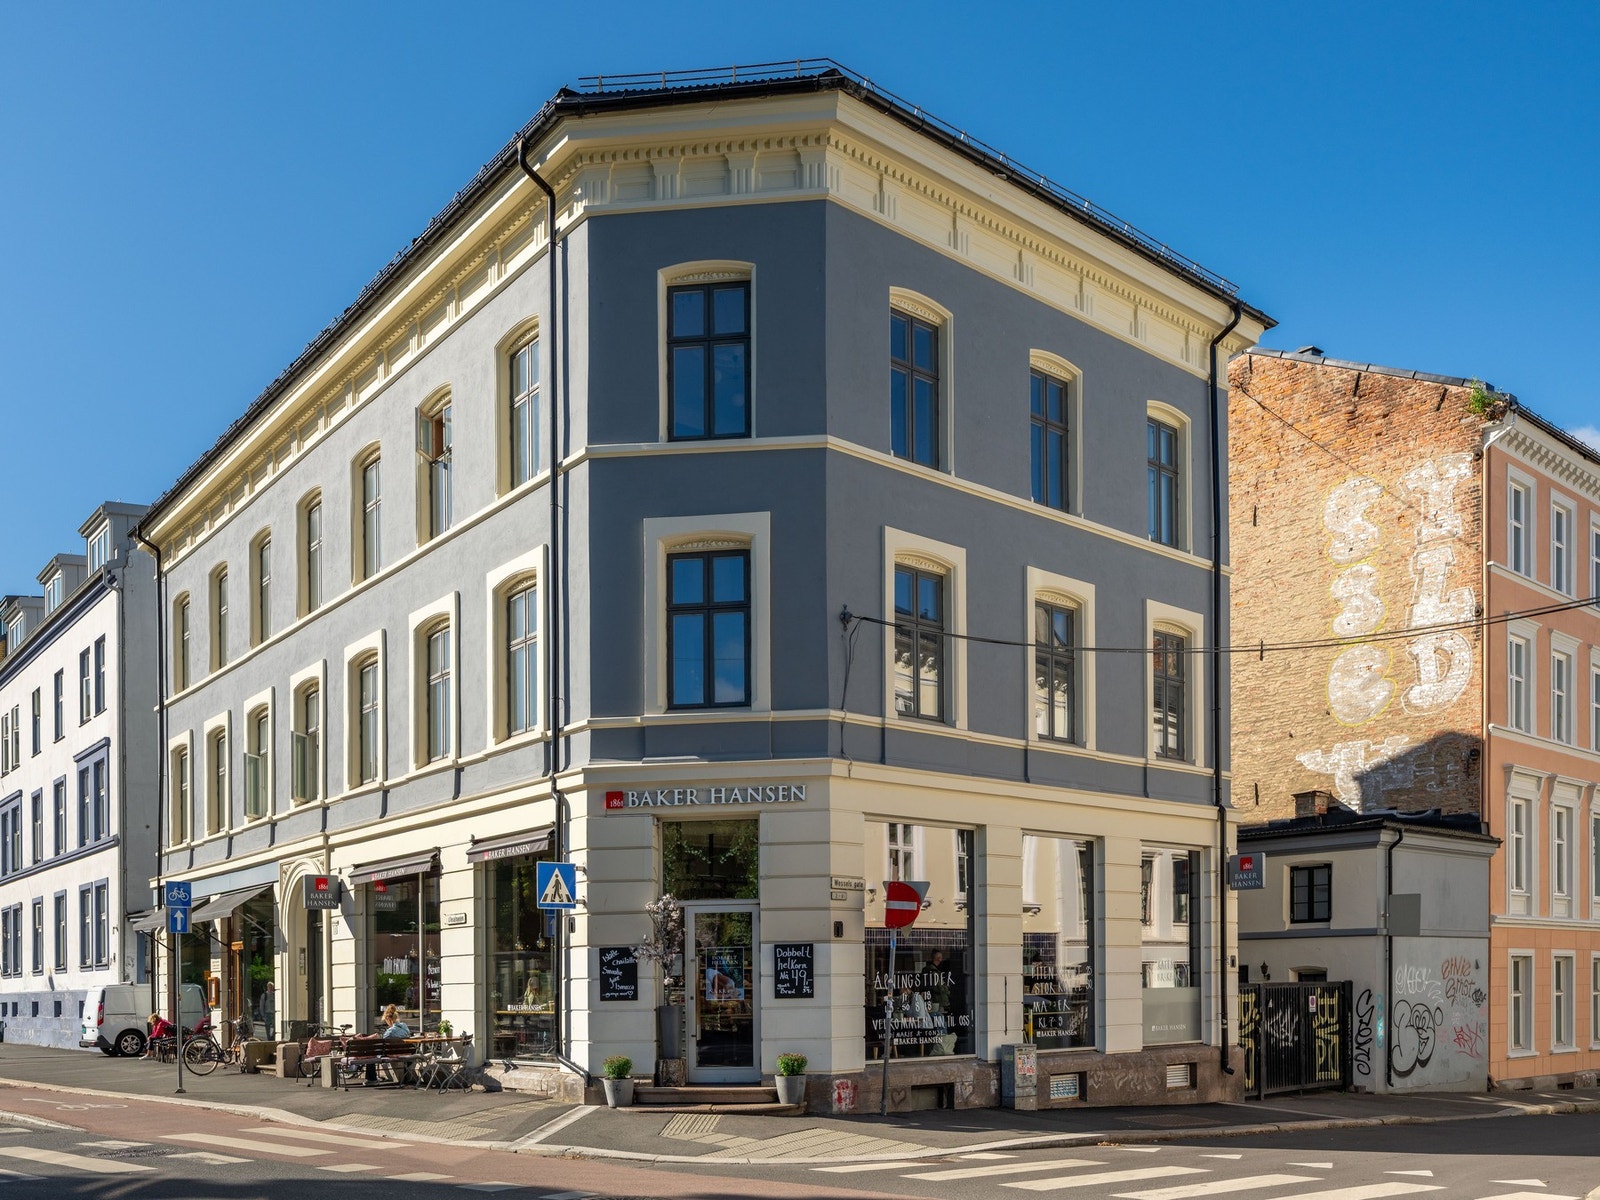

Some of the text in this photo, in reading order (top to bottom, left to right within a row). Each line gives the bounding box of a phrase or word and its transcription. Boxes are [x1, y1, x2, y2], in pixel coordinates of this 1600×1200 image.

[628, 789, 700, 808] BAKER
[710, 785, 807, 805] HANSEN
[488, 844, 531, 860] BAKER HANSEN
[1231, 880, 1261, 888] HANSEN
[776, 946, 812, 958] Dobbelt
[1034, 982, 1056, 994] STOR
[872, 1016, 929, 1031] VELKOMMEN
[947, 1013, 956, 1028] TIL
[899, 1036, 943, 1045] BAKER HANSEN
